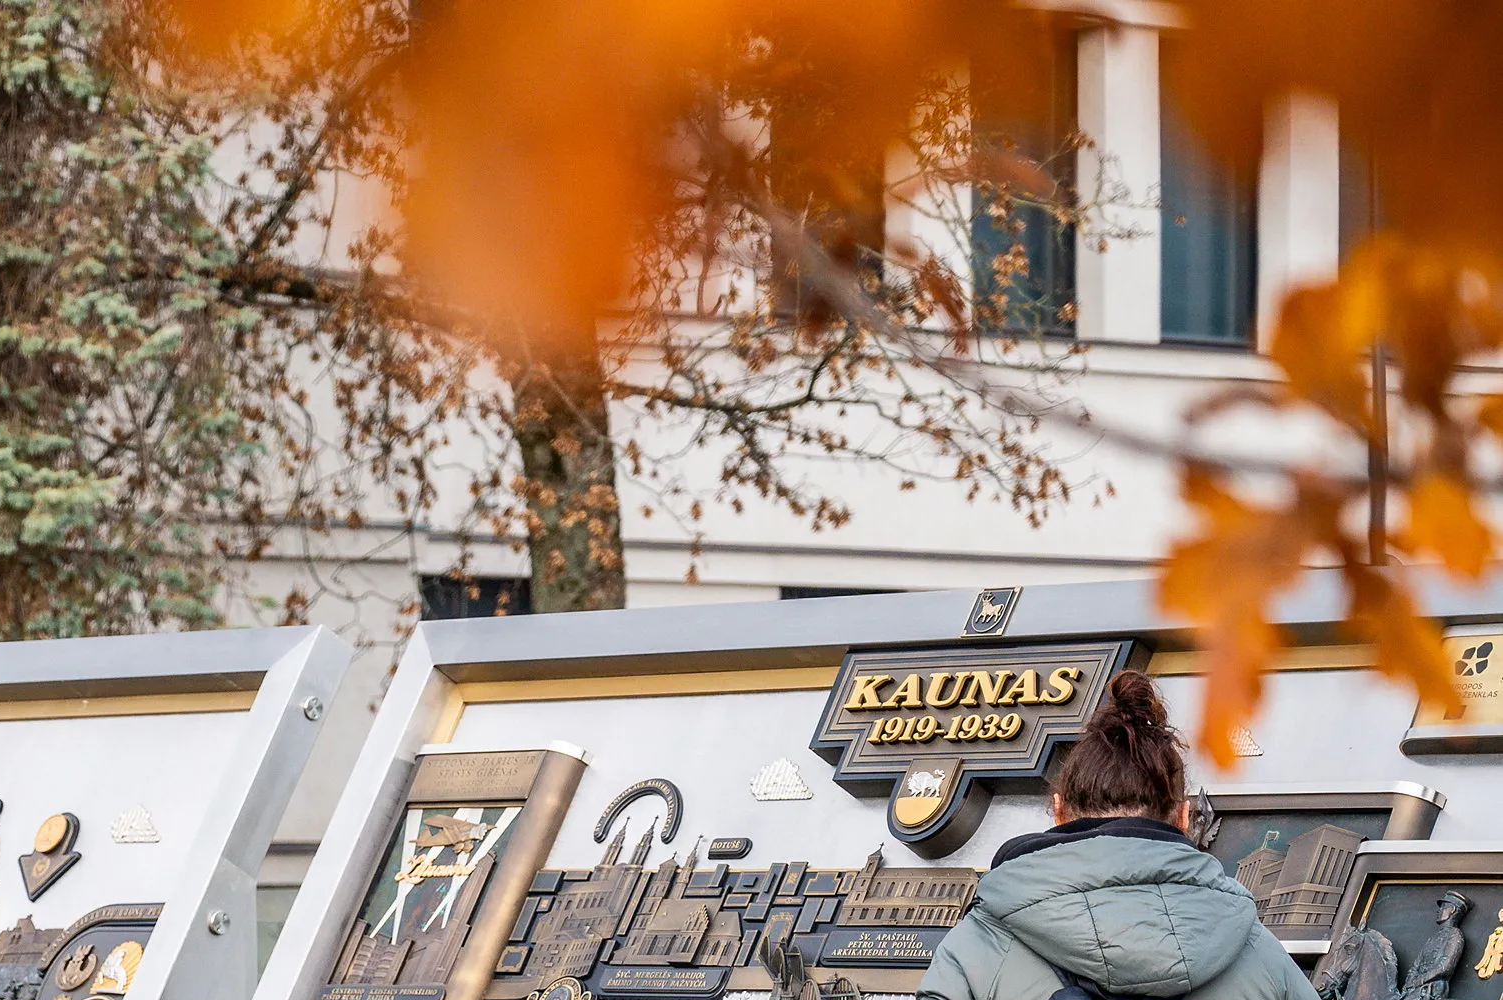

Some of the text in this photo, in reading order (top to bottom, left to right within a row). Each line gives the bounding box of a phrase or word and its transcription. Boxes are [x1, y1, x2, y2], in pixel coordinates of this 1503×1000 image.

[844, 667, 1079, 710] KAUNAS
[867, 713, 1022, 743] 1919-1939
[875, 932, 918, 942] APAŠTALŲ
[892, 941, 923, 949] POVILO
[832, 949, 889, 957] ARKIKATEDRA
[673, 972, 706, 980] MARIJOS
[670, 978, 706, 988] BAŽNYČIA
